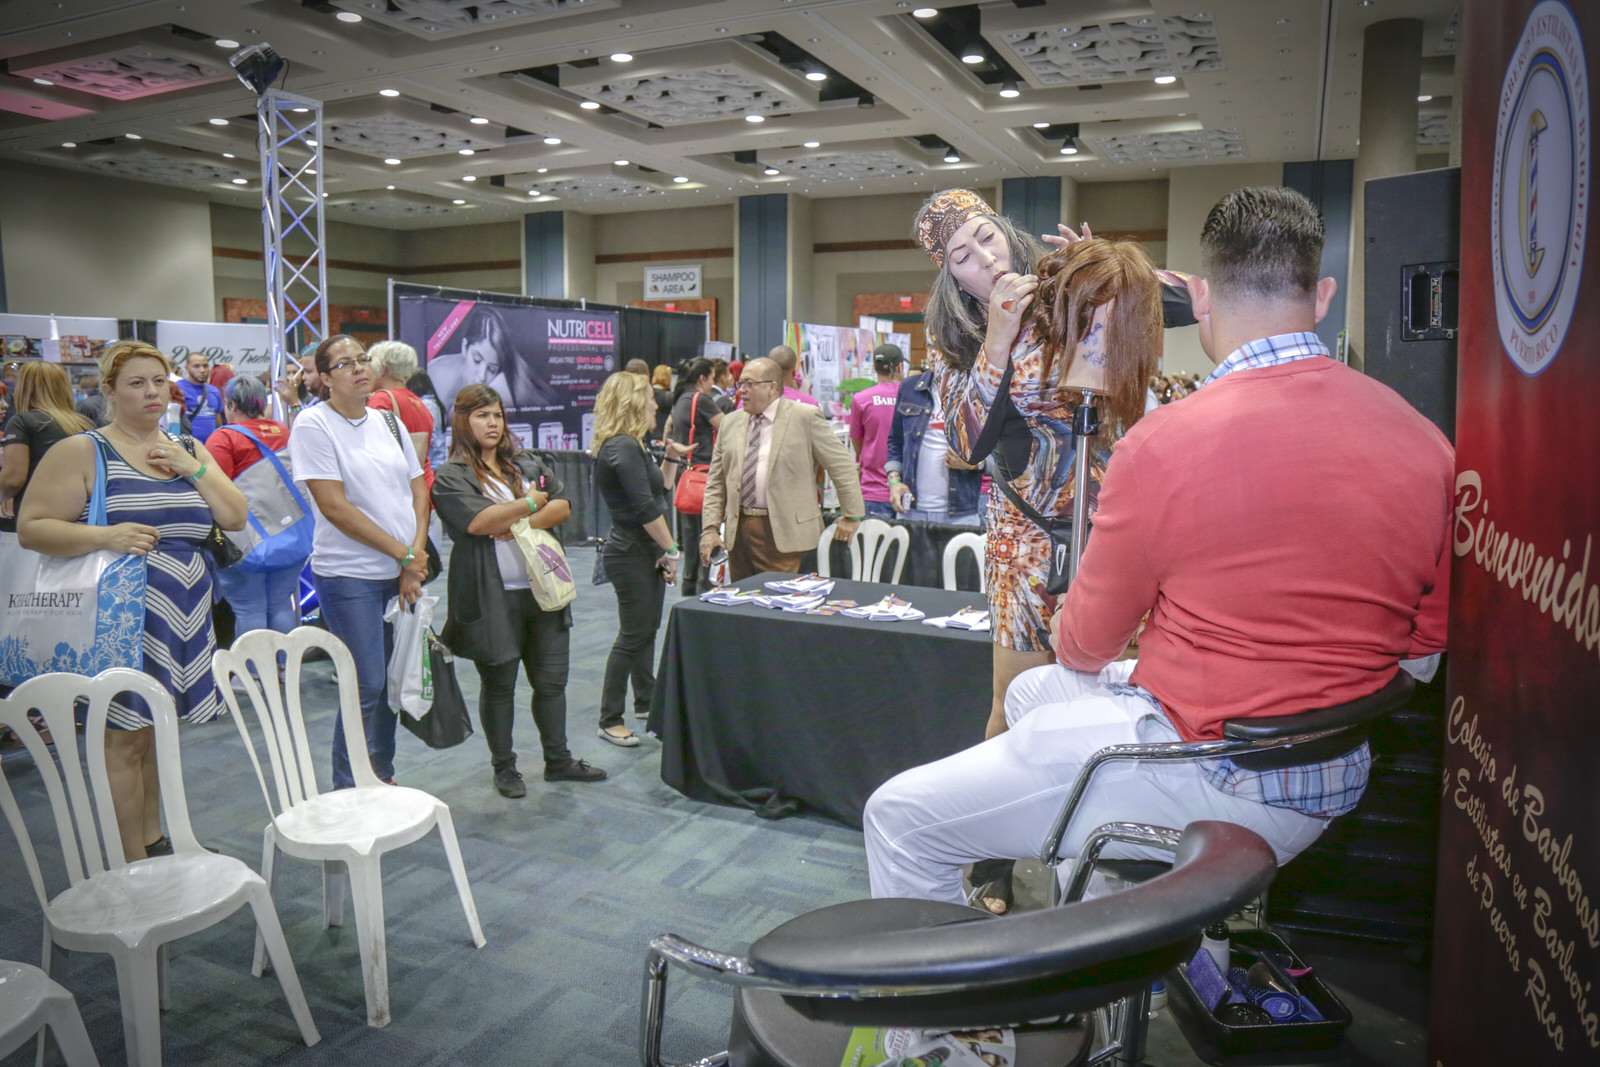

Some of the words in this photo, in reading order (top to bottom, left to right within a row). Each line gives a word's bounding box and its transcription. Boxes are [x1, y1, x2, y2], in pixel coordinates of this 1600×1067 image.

[651, 272, 697, 282] SHAMPOO
[662, 284, 685, 293] AREA
[547, 319, 614, 339] NUTRICELL
[1535, 323, 1559, 362] RICO
[1454, 470, 1600, 660] Bienvenido
[1443, 768, 1450, 798] y
[1454, 768, 1512, 879] Estilistas
[1513, 873, 1528, 911] en
[1447, 695, 1496, 783] Colegio
[1502, 764, 1520, 816] de
[1523, 783, 1600, 949] Barberos
[1466, 854, 1479, 893] de
[1480, 872, 1520, 973] Puerto
[1525, 957, 1564, 1052] Rico
